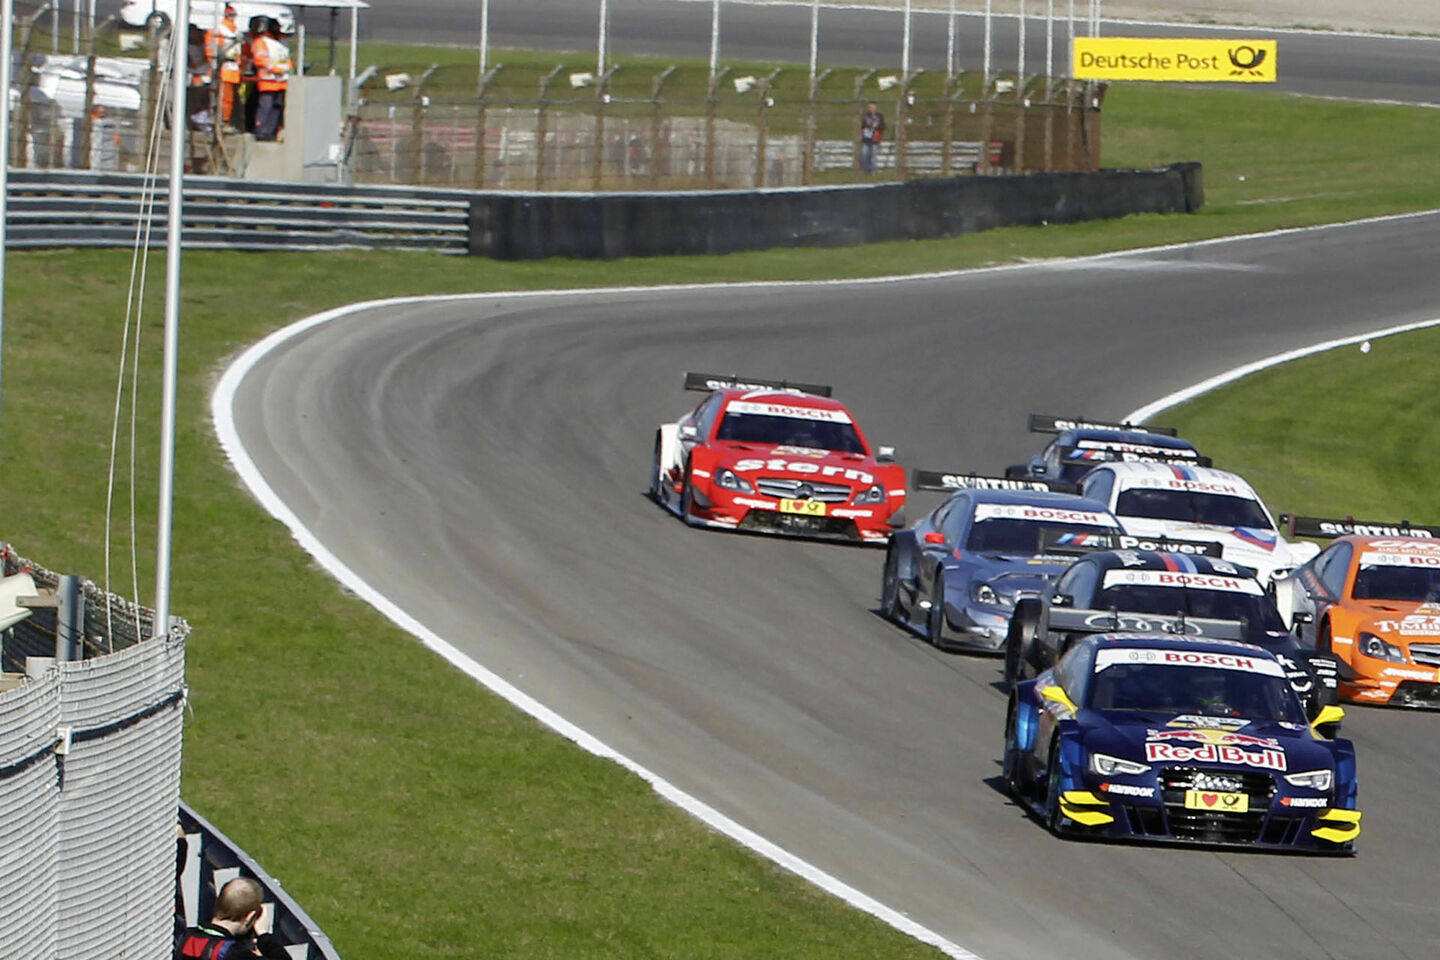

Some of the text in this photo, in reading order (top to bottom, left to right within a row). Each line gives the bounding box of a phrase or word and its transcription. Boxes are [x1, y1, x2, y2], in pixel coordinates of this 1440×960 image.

[1081, 52, 1220, 70] Deutsche Post
[767, 406, 833, 419] BOSCH
[734, 459, 875, 484] stern
[1168, 480, 1237, 493] BOSCH
[1023, 508, 1099, 522] BOSCH
[1119, 535, 1207, 555] Power
[1158, 573, 1241, 589] BOSCH
[1164, 652, 1254, 669] BOSCH
[1148, 743, 1285, 770] Red Bull
